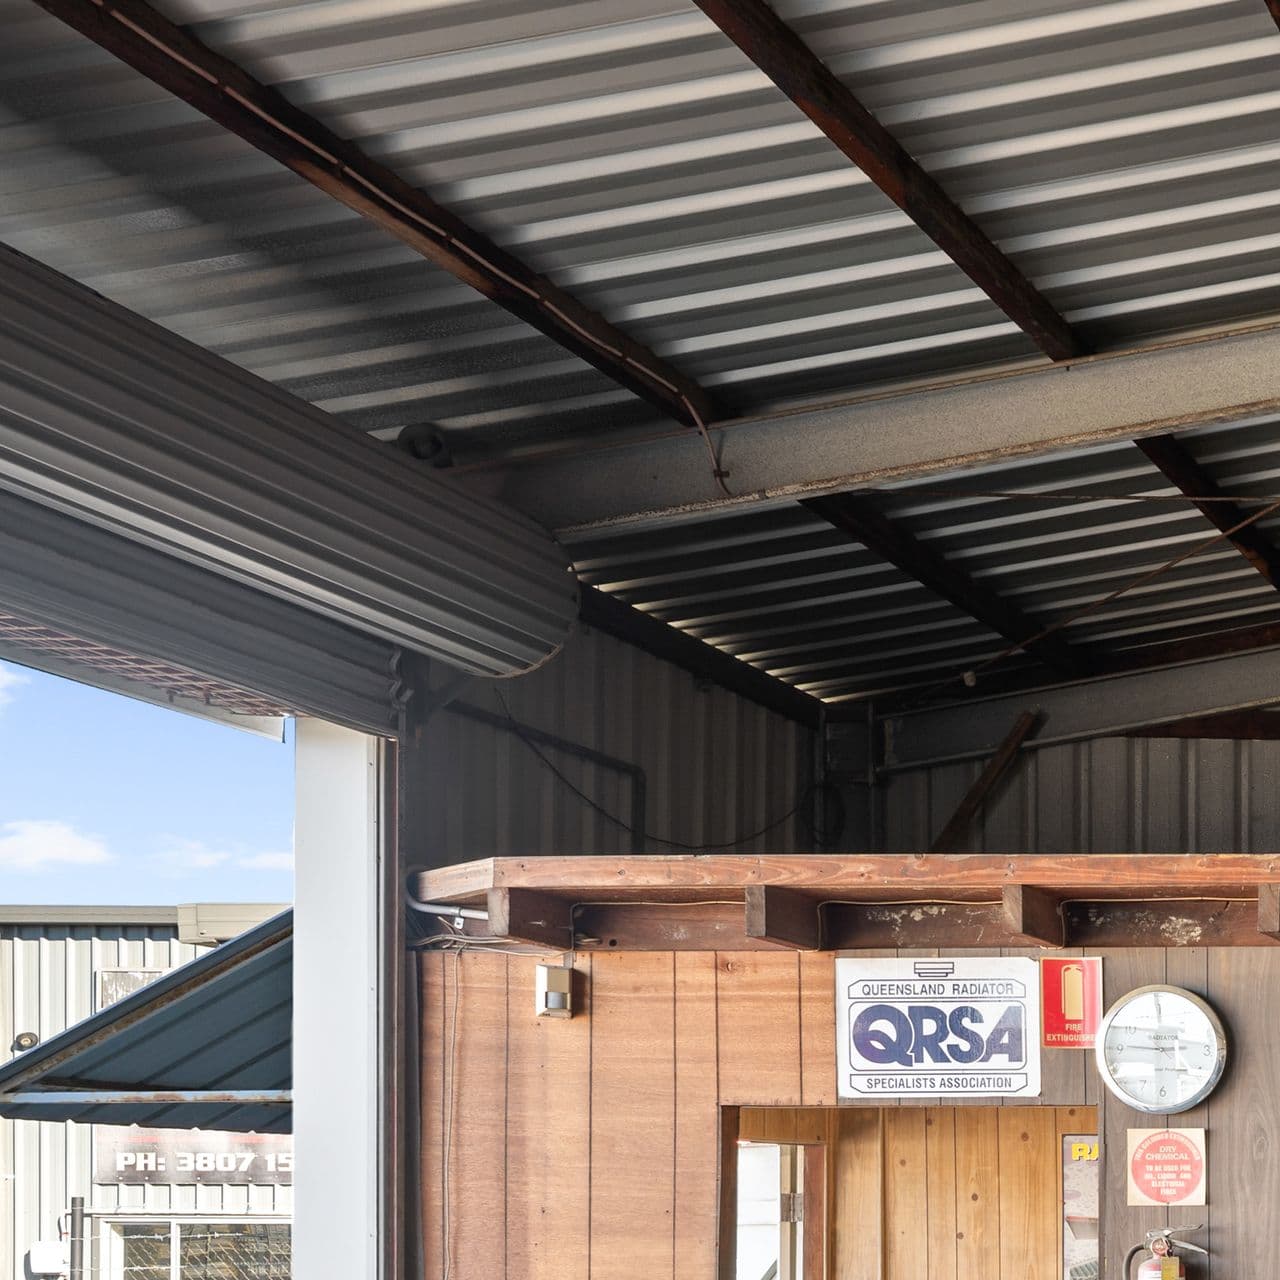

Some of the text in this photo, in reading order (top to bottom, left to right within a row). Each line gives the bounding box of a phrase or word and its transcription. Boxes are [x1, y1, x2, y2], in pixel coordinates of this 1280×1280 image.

[862, 983, 1015, 997] QUEENSLAND RADIATOR
[1065, 1023, 1081, 1031] FIRE
[852, 1004, 1023, 1067] QRSA
[1046, 1033, 1097, 1041] EXTINGUISHE
[866, 1077, 1012, 1089] SPECIALISTS ASSOCIATION
[1159, 1145, 1177, 1153] DRY
[116, 1151, 166, 1172] PH:
[175, 1151, 257, 1172] 3807
